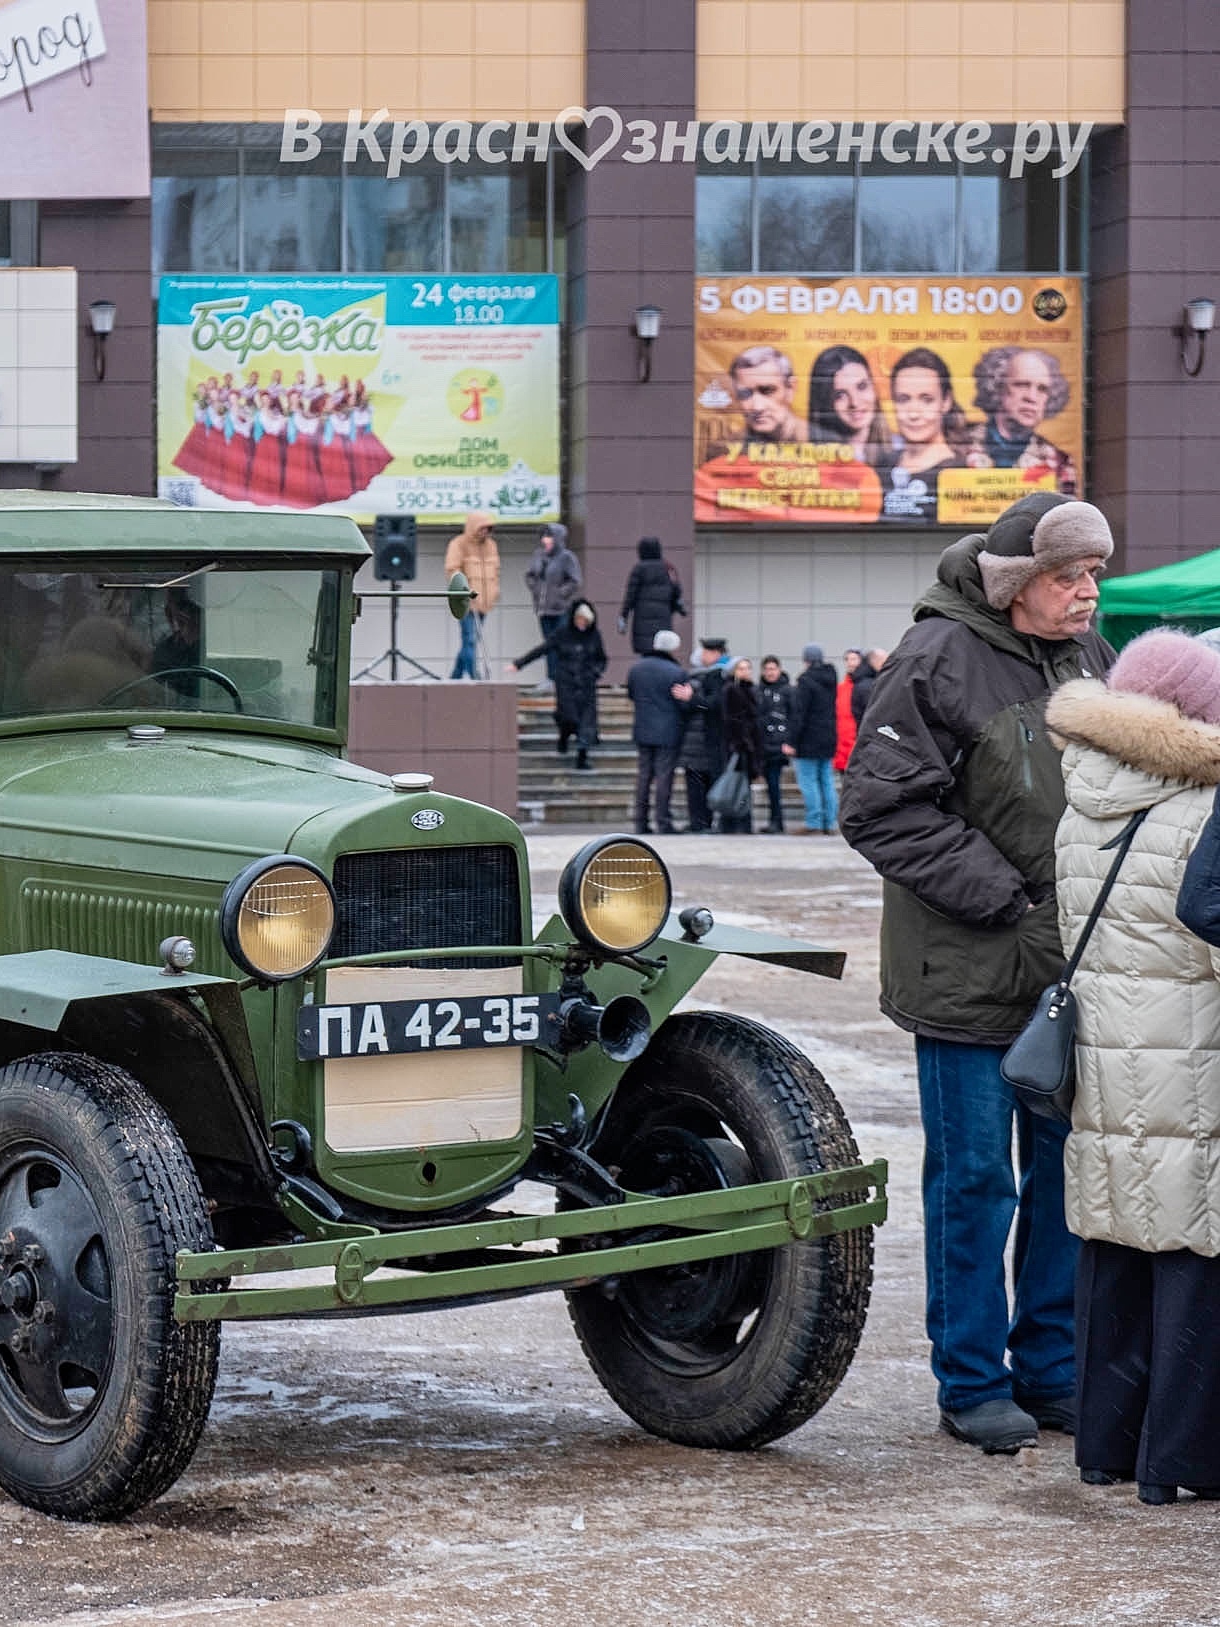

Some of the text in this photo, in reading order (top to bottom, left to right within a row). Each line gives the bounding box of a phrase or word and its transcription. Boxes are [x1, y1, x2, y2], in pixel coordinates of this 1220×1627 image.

[412, 283, 444, 308] 24
[448, 283, 536, 303] февраля
[699, 286, 720, 314] 5
[731, 285, 919, 315] ФЕВРАЛЯ
[928, 286, 1024, 314] 18:00
[458, 437, 499, 451] ДОМ
[413, 454, 509, 468] ОФИЦЕРОВ
[318, 996, 539, 1056] ПА 42-35
